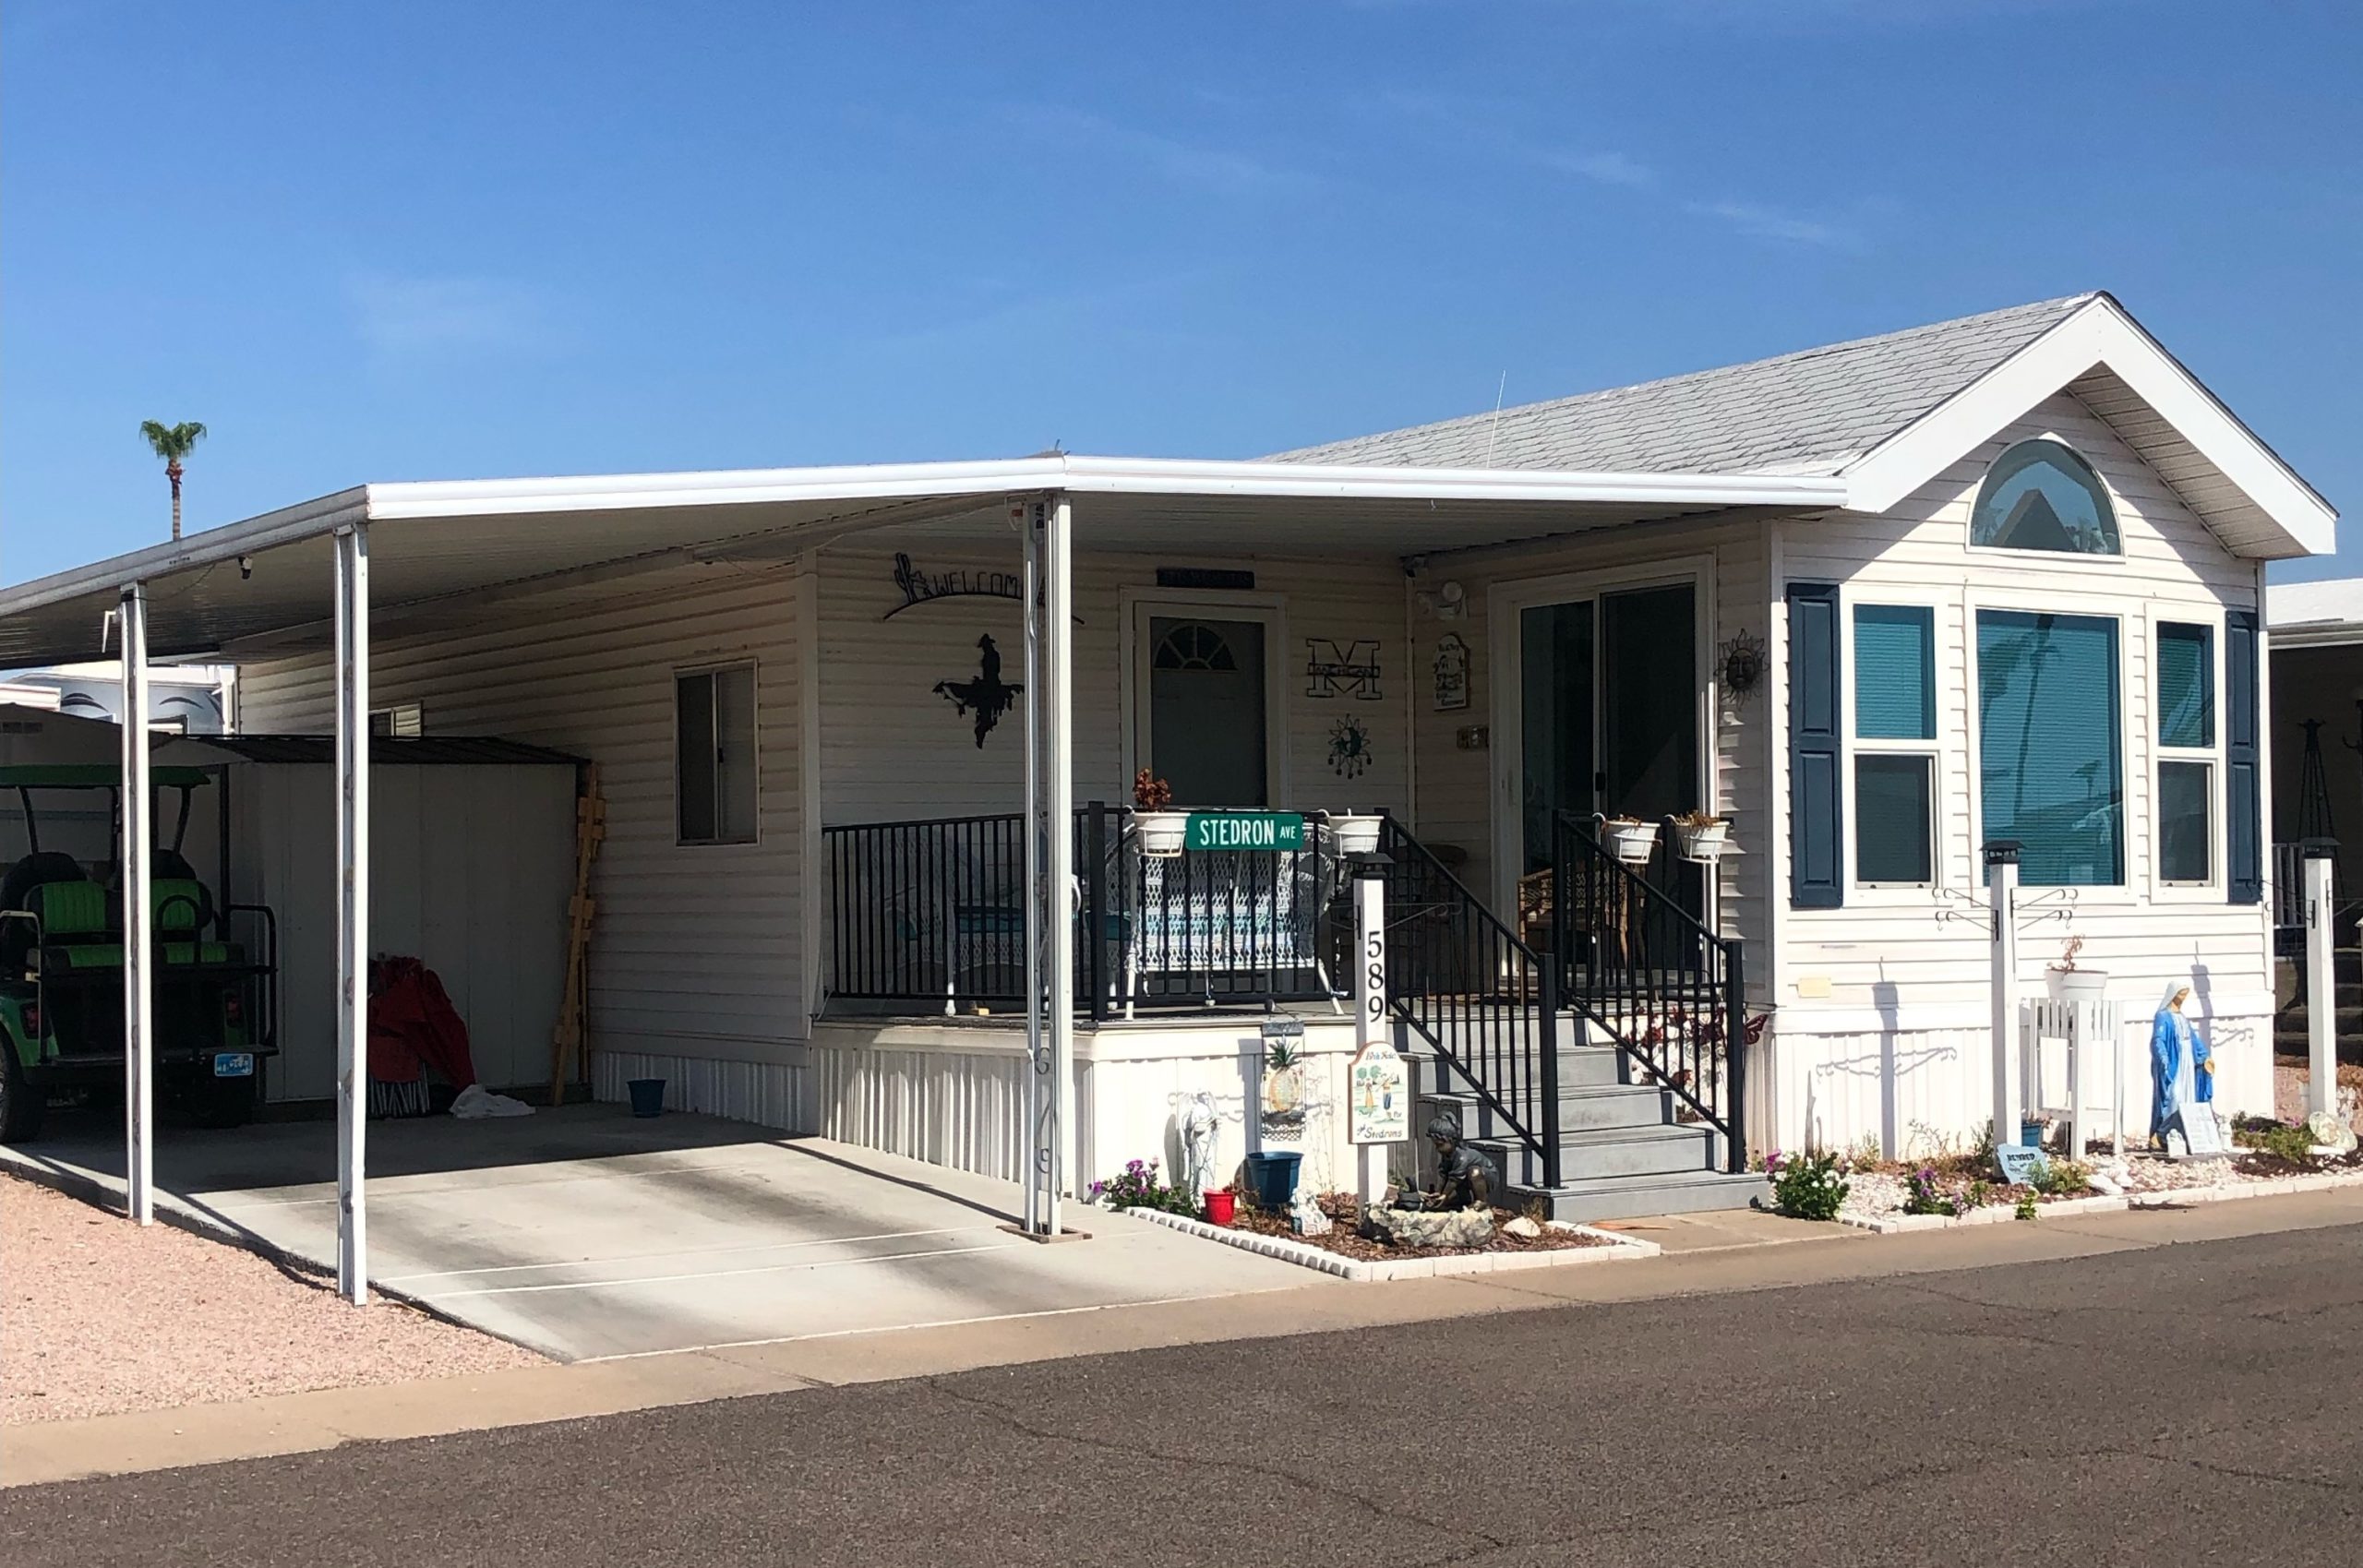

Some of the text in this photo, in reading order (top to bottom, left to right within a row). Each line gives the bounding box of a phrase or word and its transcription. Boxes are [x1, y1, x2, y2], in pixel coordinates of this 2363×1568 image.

[933, 570, 1025, 598] WELCOM
[1200, 820, 1296, 845] STEDRON AVE
[1367, 930, 1384, 1023] 589
